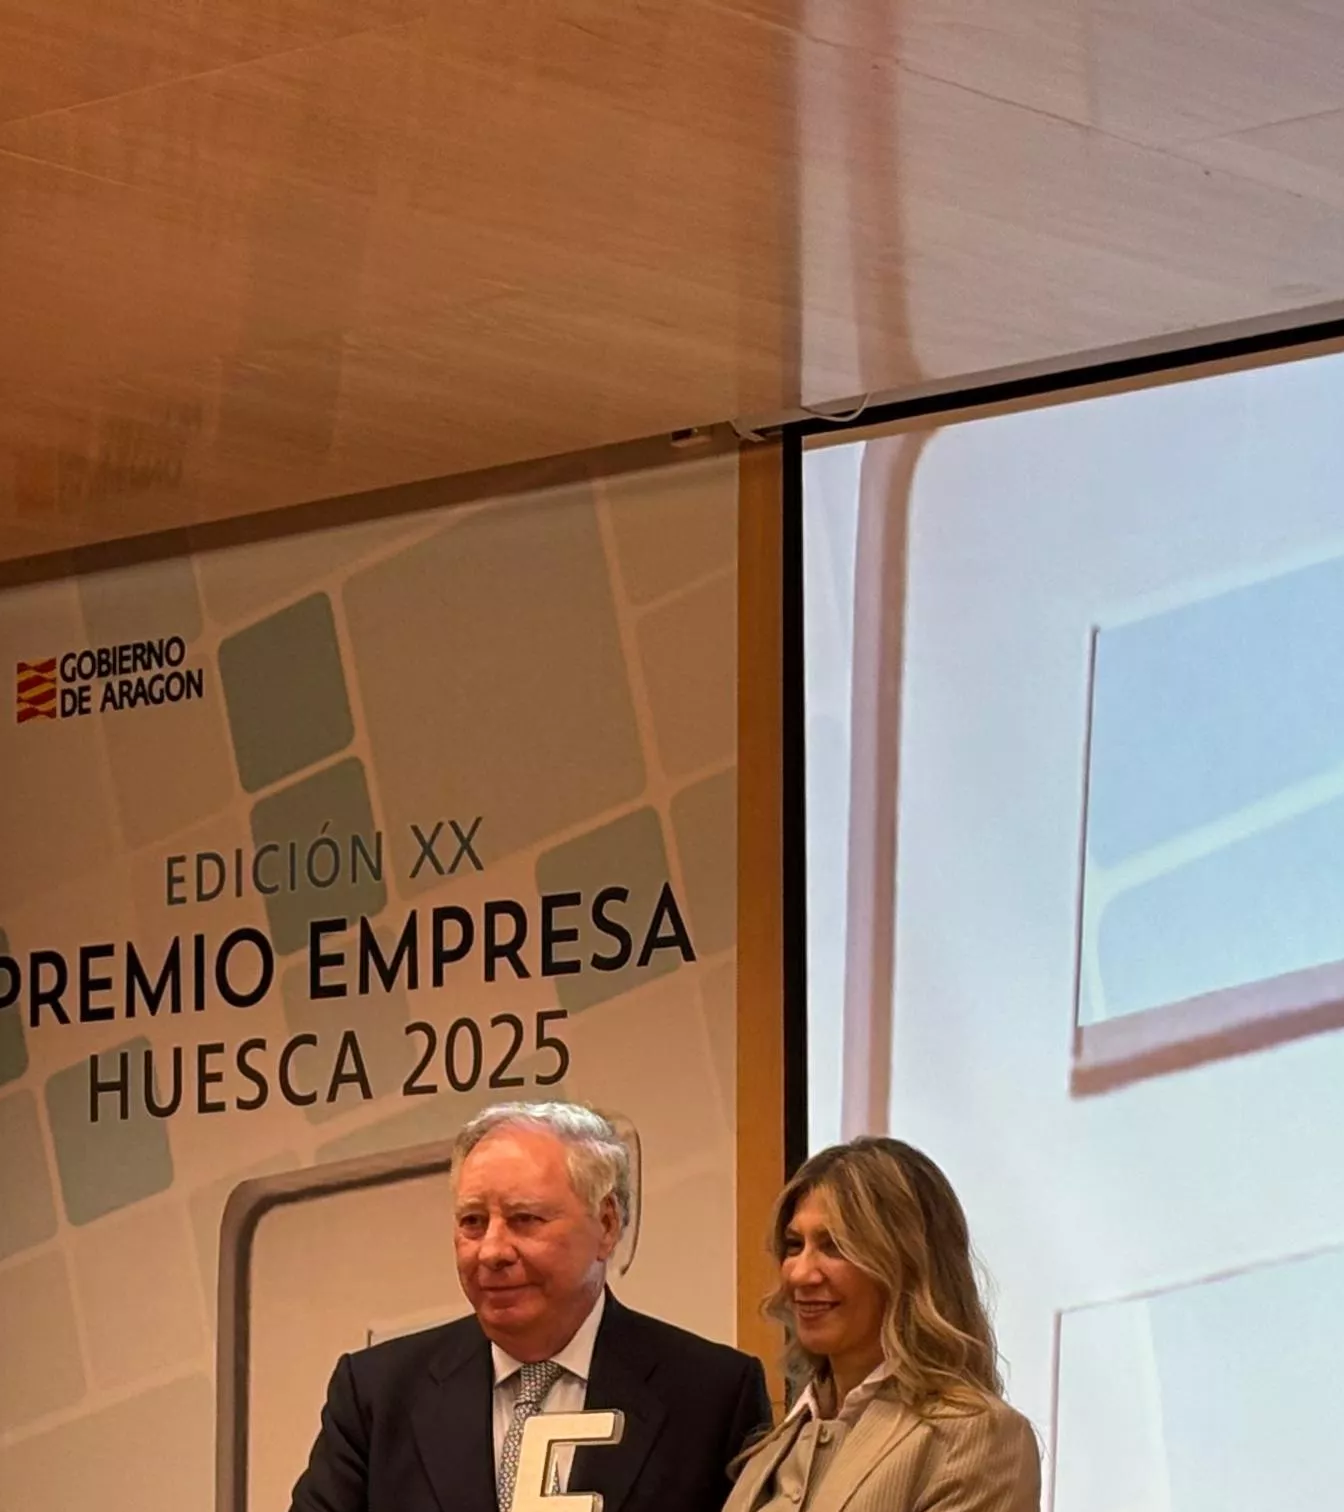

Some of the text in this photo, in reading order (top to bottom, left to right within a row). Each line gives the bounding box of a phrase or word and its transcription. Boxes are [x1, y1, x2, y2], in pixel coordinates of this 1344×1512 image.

[60, 635, 186, 683] GOBIERNO
[61, 668, 204, 718] DE ARAGON
[166, 816, 484, 906] EDICIÓN XX
[309, 881, 697, 1001] EMPRESA
[89, 1008, 570, 1124] HUESCA 2025
